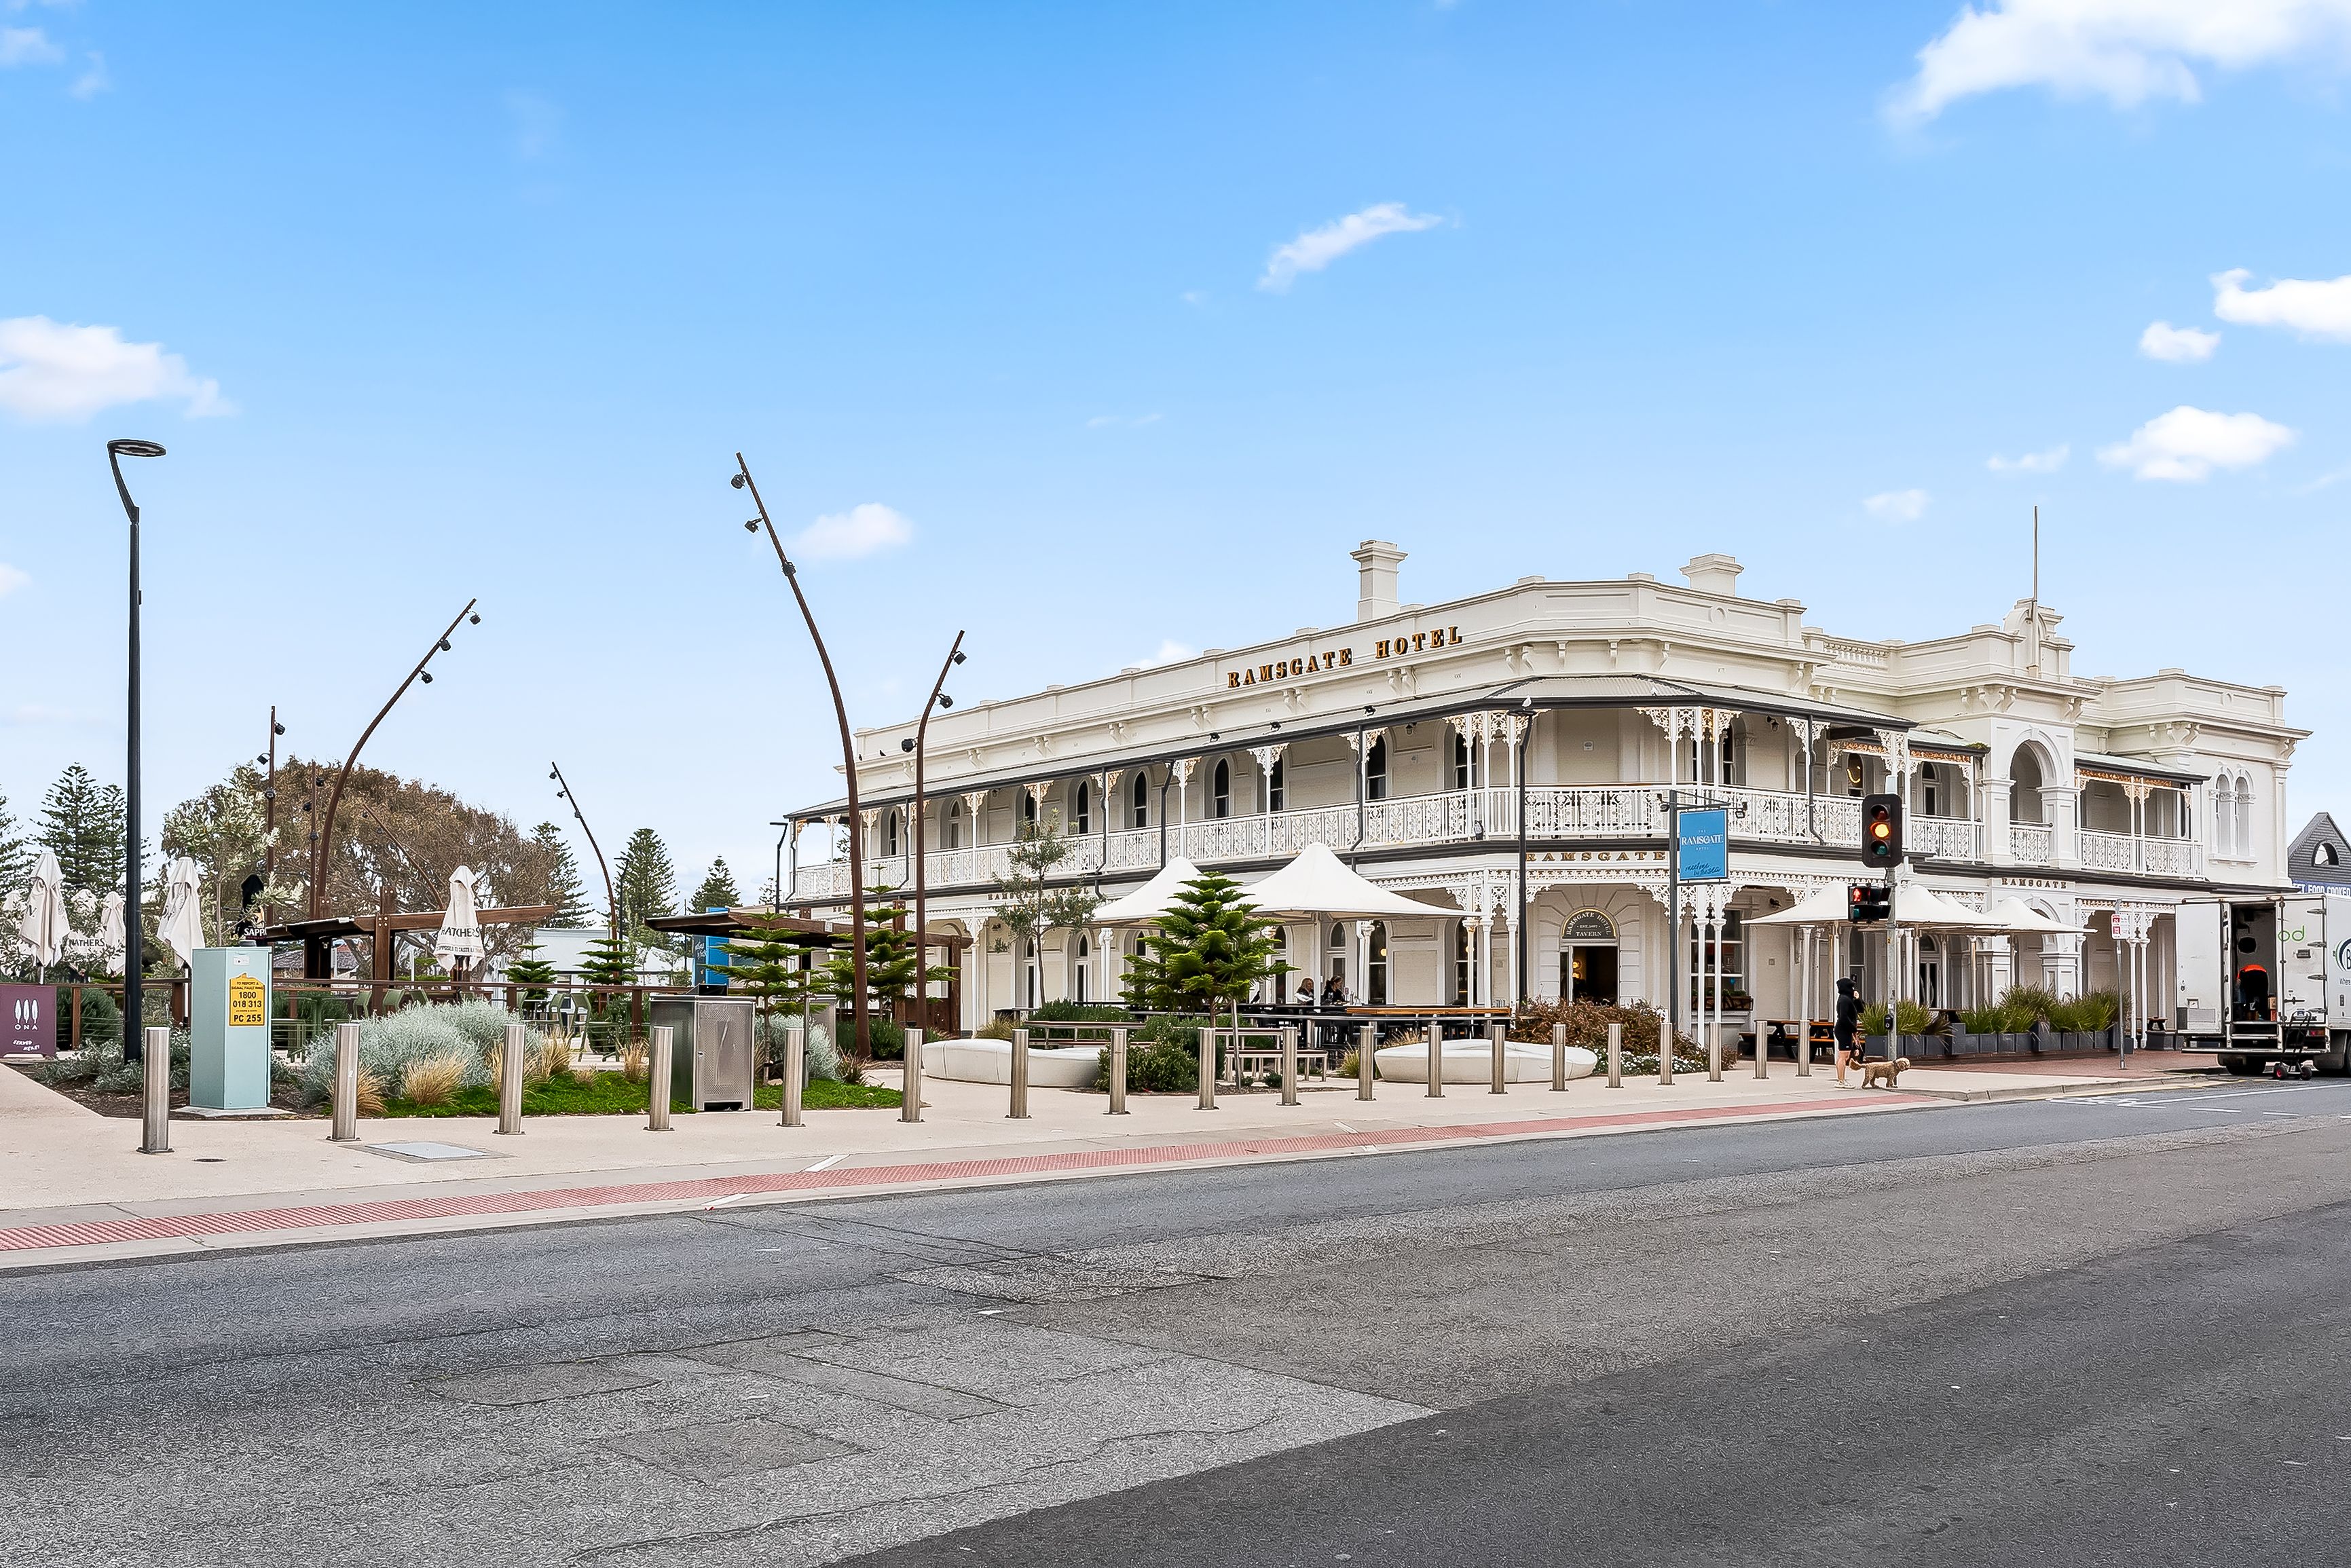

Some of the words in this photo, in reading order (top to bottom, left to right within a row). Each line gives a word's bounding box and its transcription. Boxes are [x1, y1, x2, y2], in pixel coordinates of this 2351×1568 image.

[1227, 648, 1352, 688] RAMSGATE
[1375, 626, 1462, 658] HOTEL
[1682, 834, 1724, 845] RAMSGATE
[1525, 852, 1666, 861] RAMSGATE
[2002, 878, 2067, 889] RAMSGATE
[2308, 884, 2325, 893] FOOD
[1567, 912, 1595, 935] RAMSGATE
[1597, 915, 1611, 935] HOTEL
[246, 1014, 261, 1022] 255
